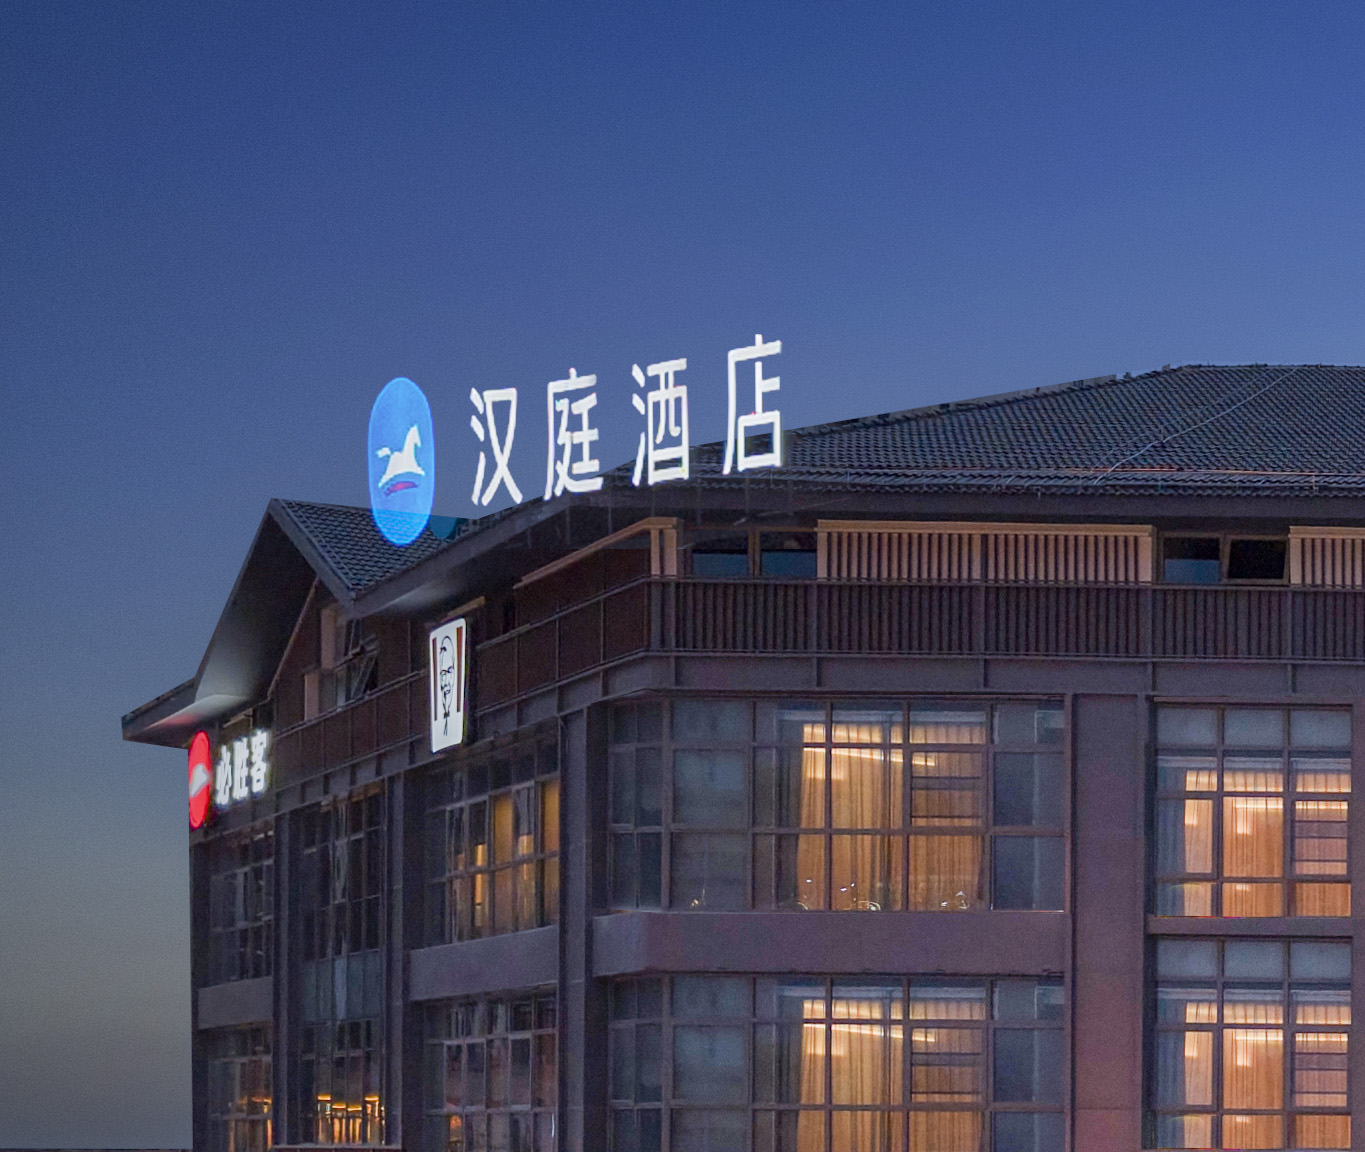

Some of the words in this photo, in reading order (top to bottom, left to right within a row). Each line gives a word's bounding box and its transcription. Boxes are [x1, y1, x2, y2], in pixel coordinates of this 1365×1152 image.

[470, 334, 782, 506] 汉庭酒店
[215, 729, 268, 806] 必胜客
